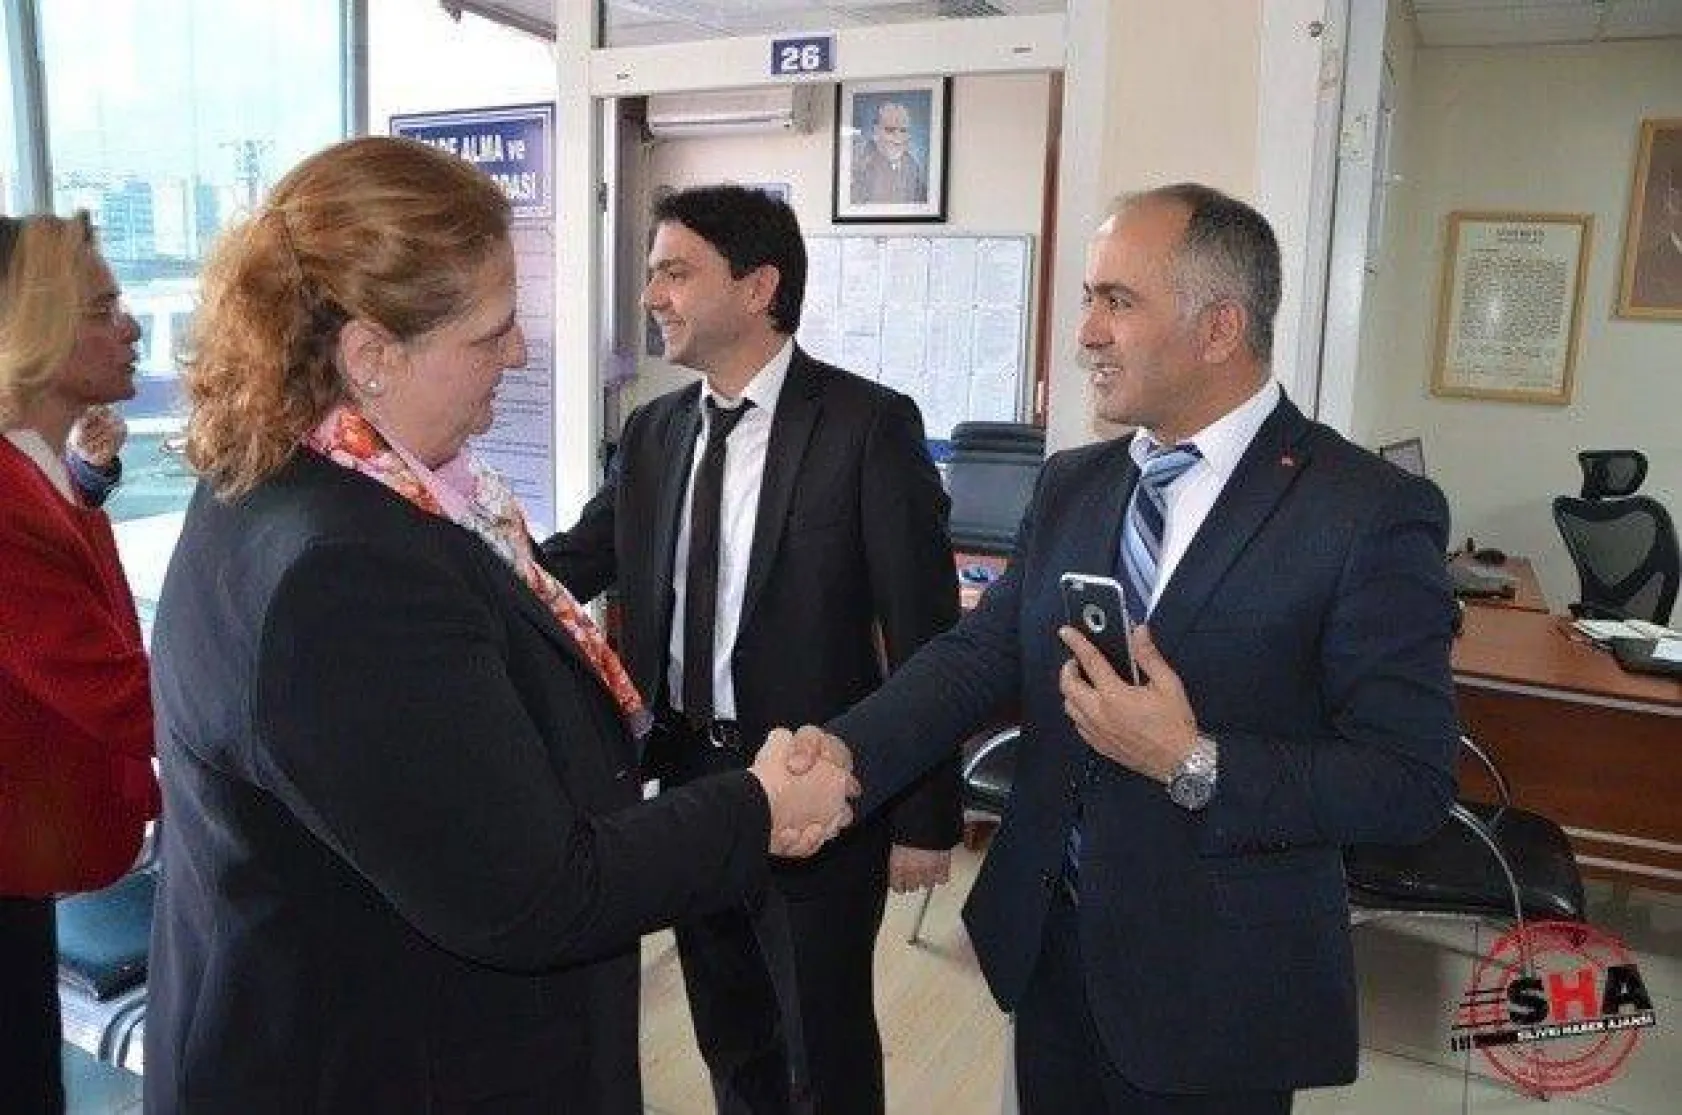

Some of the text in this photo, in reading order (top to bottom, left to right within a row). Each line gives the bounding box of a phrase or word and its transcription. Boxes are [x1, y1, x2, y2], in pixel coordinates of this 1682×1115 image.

[781, 45, 820, 70] 26
[460, 135, 504, 163] ALMA
[507, 139, 525, 160] ve
